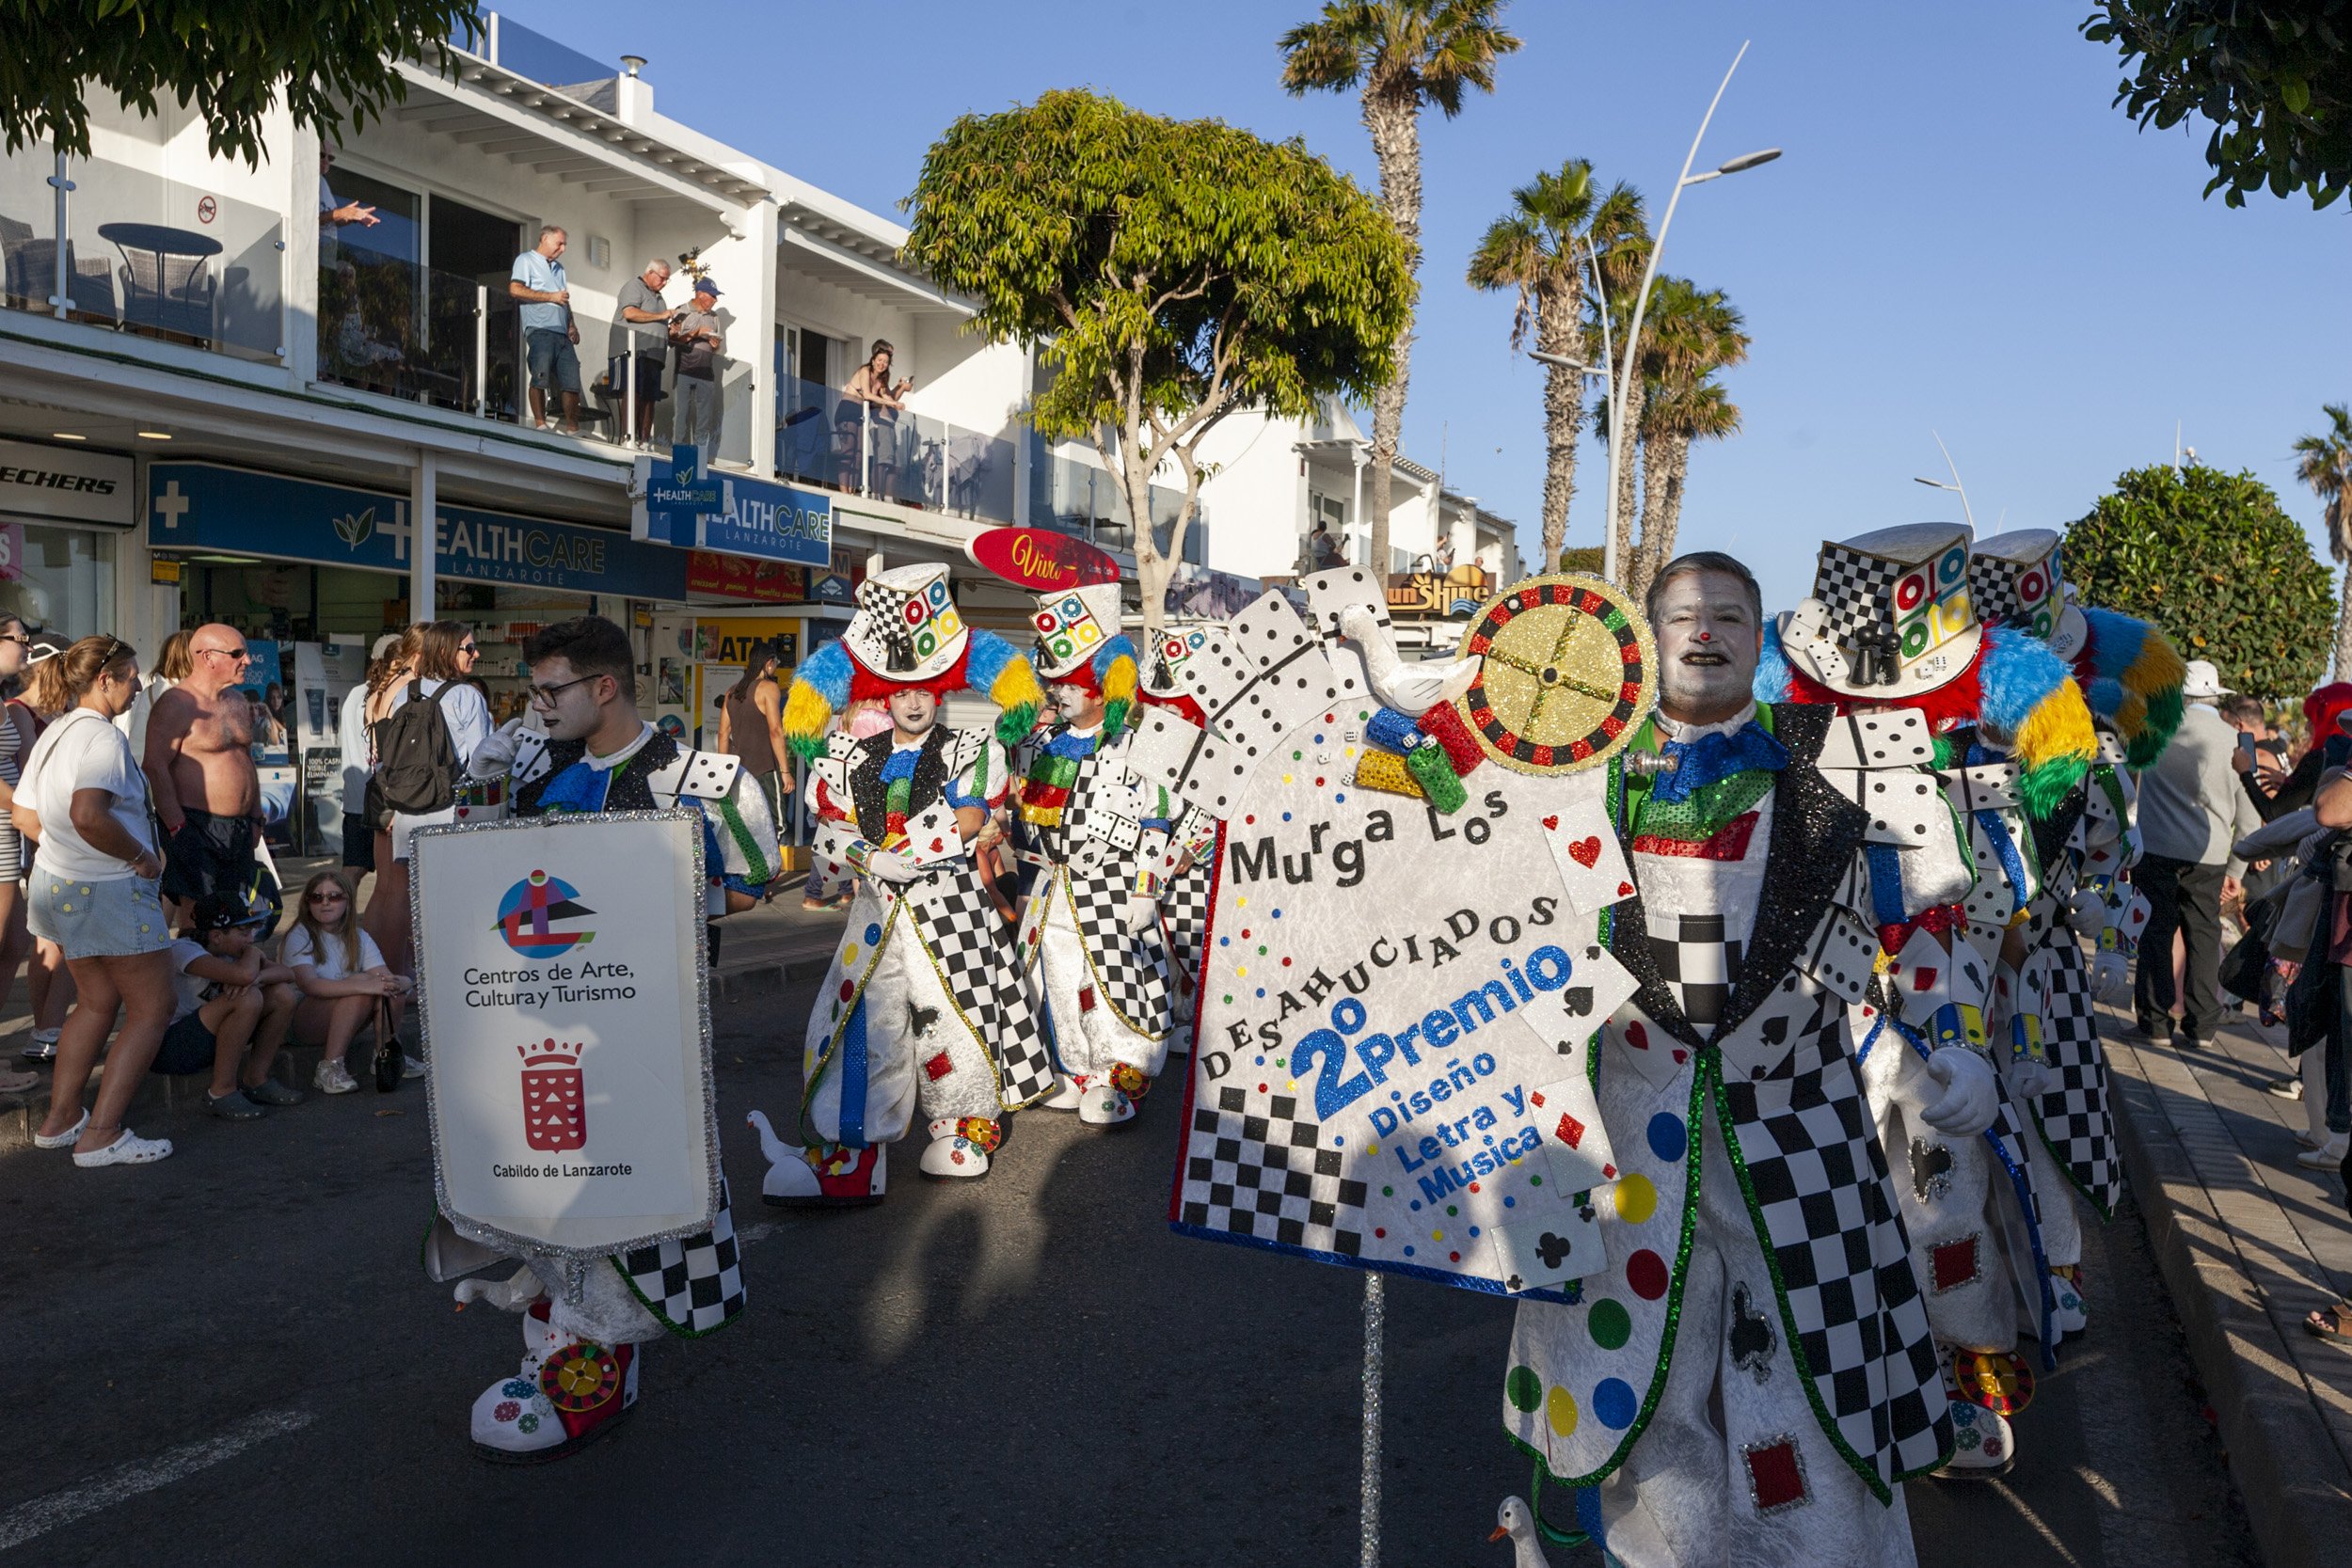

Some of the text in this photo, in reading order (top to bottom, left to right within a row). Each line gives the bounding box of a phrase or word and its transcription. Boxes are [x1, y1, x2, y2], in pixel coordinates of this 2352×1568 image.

[663, 489, 716, 502] HEALTHCARE
[707, 497, 829, 543] ALTHCARE
[725, 530, 802, 550] LANZAROTE
[435, 516, 605, 575] EALTHCARE
[1012, 533, 1062, 580] Viva
[453, 562, 564, 585] LANZAROTE
[1230, 790, 1508, 887] Murga Los
[464, 960, 635, 986] Centros de Arte,
[465, 984, 636, 1009] Cultura y Turismo
[1200, 895, 1558, 1082] DESAHUCIADOS
[1354, 944, 1572, 1087] Premio
[1368, 1052, 1498, 1139] Diseño
[1394, 1085, 1527, 1174] Letra y
[492, 1163, 632, 1178] Cabildo de Lanzarote
[1417, 1125, 1545, 1207] Musica
